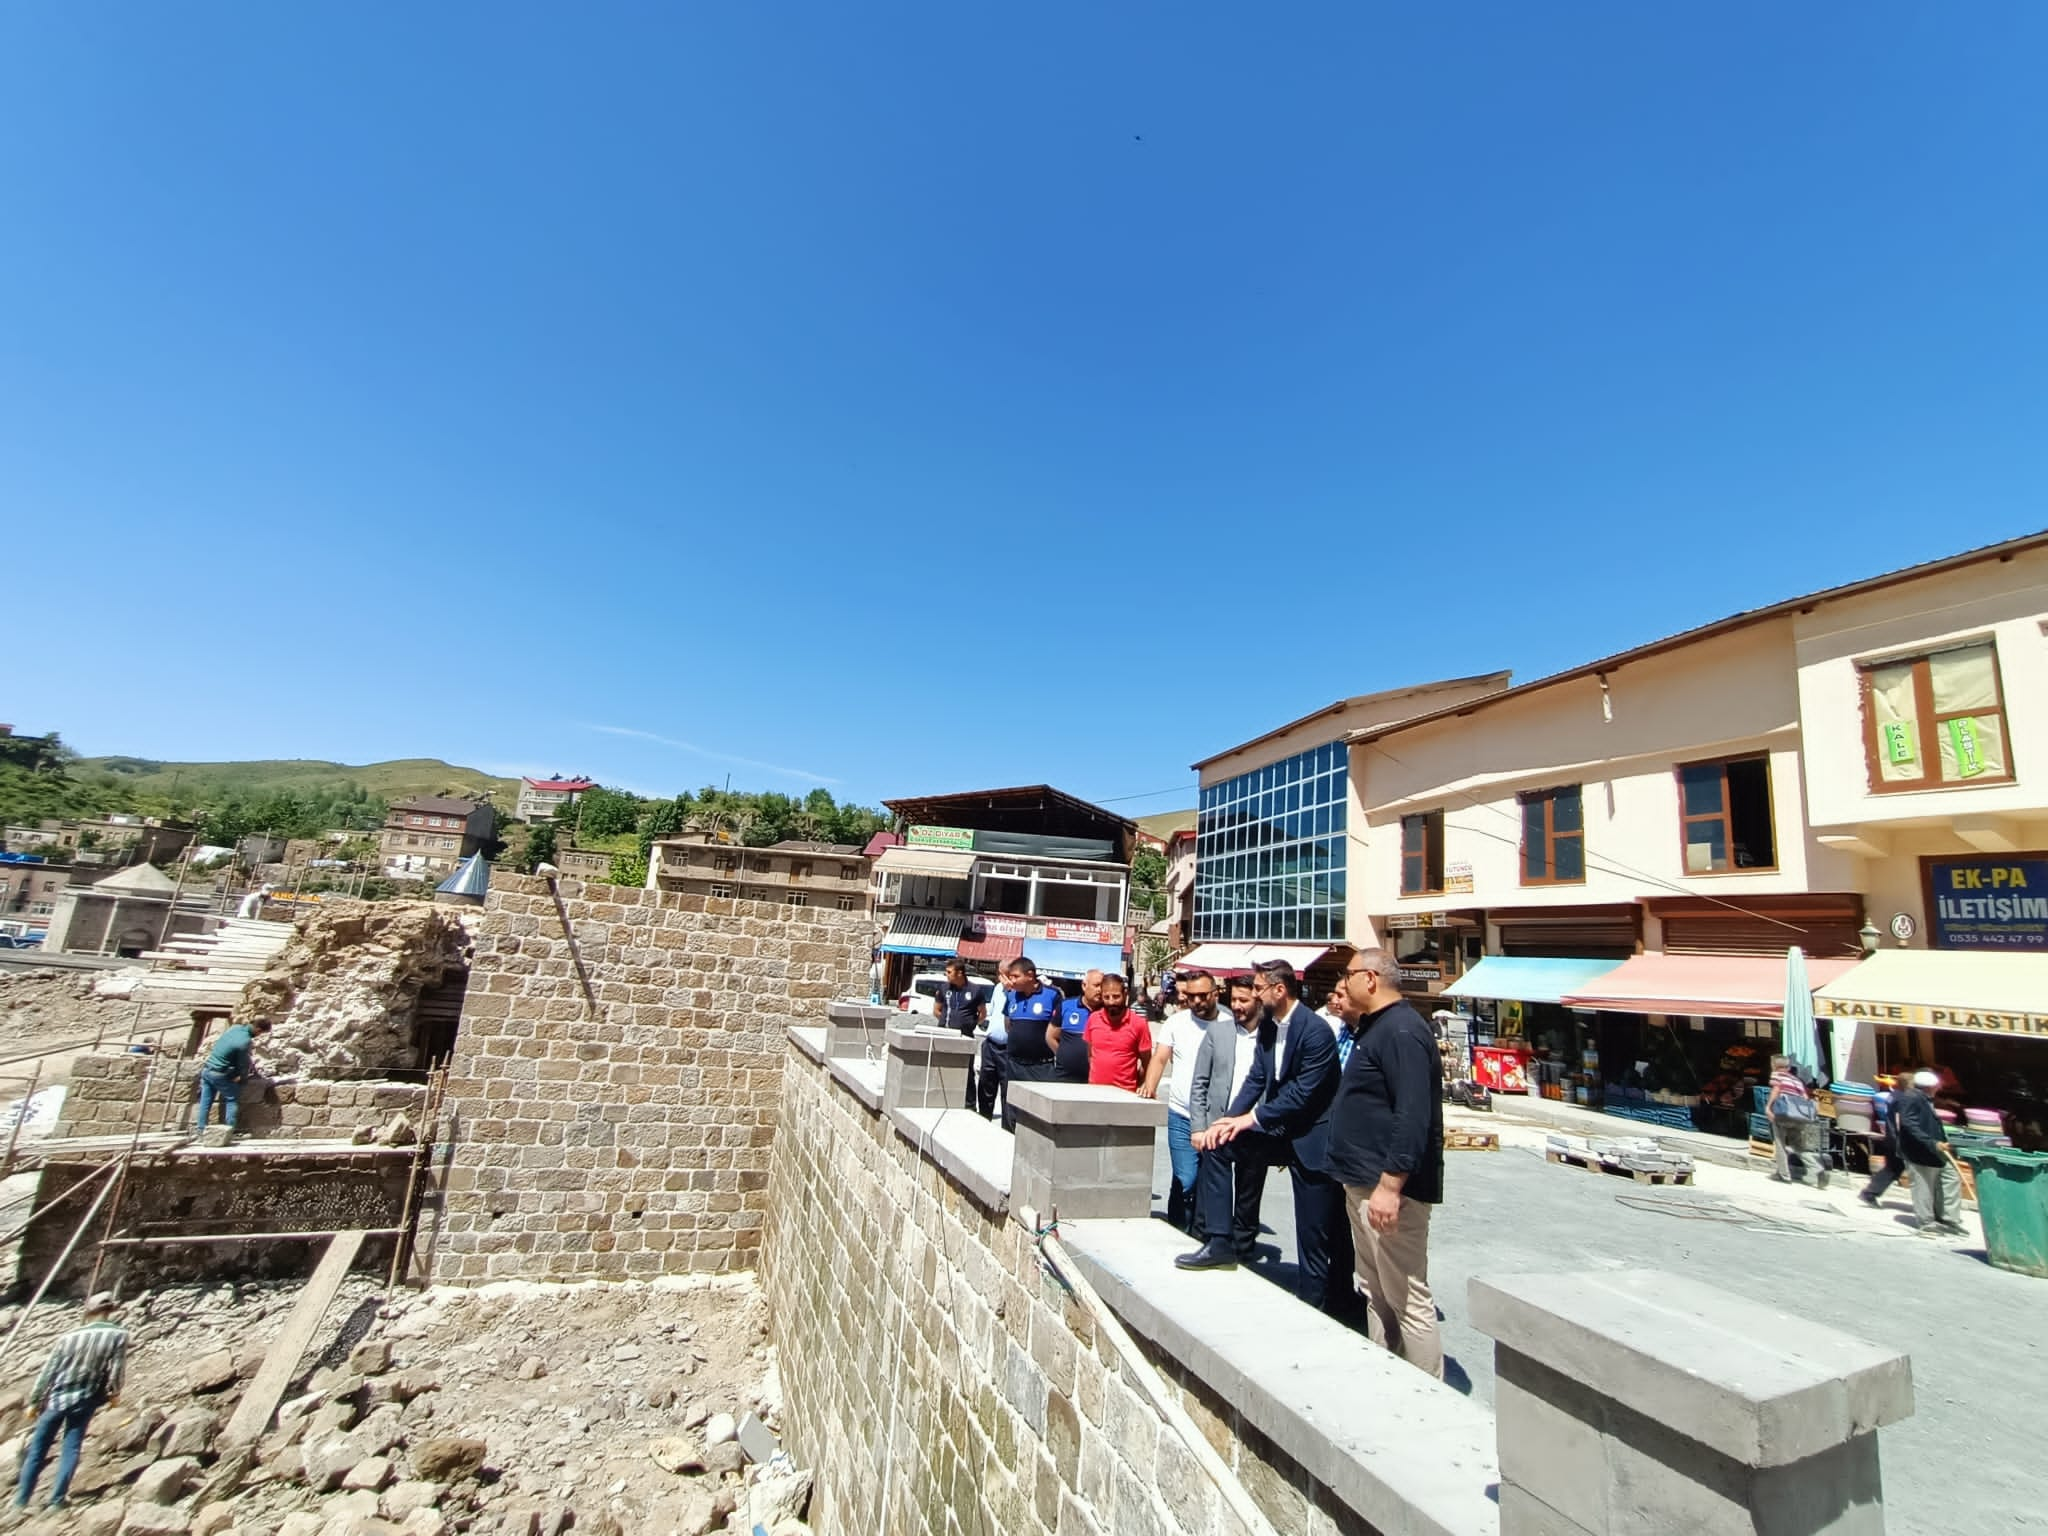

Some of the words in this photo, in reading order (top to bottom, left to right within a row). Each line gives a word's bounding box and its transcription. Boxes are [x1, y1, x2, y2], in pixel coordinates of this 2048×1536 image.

[1892, 724, 1906, 757] KALE
[1951, 867, 2027, 889] EK-PA
[1938, 894, 2048, 921] İLETİŞİM
[1949, 934, 1978, 943] 0535
[1982, 935, 2005, 943] 442
[2008, 935, 2022, 943] 47
[2027, 935, 2044, 943] 99
[1830, 1001, 1903, 1018] KALE
[1931, 1009, 2048, 1034] PLASTİK
